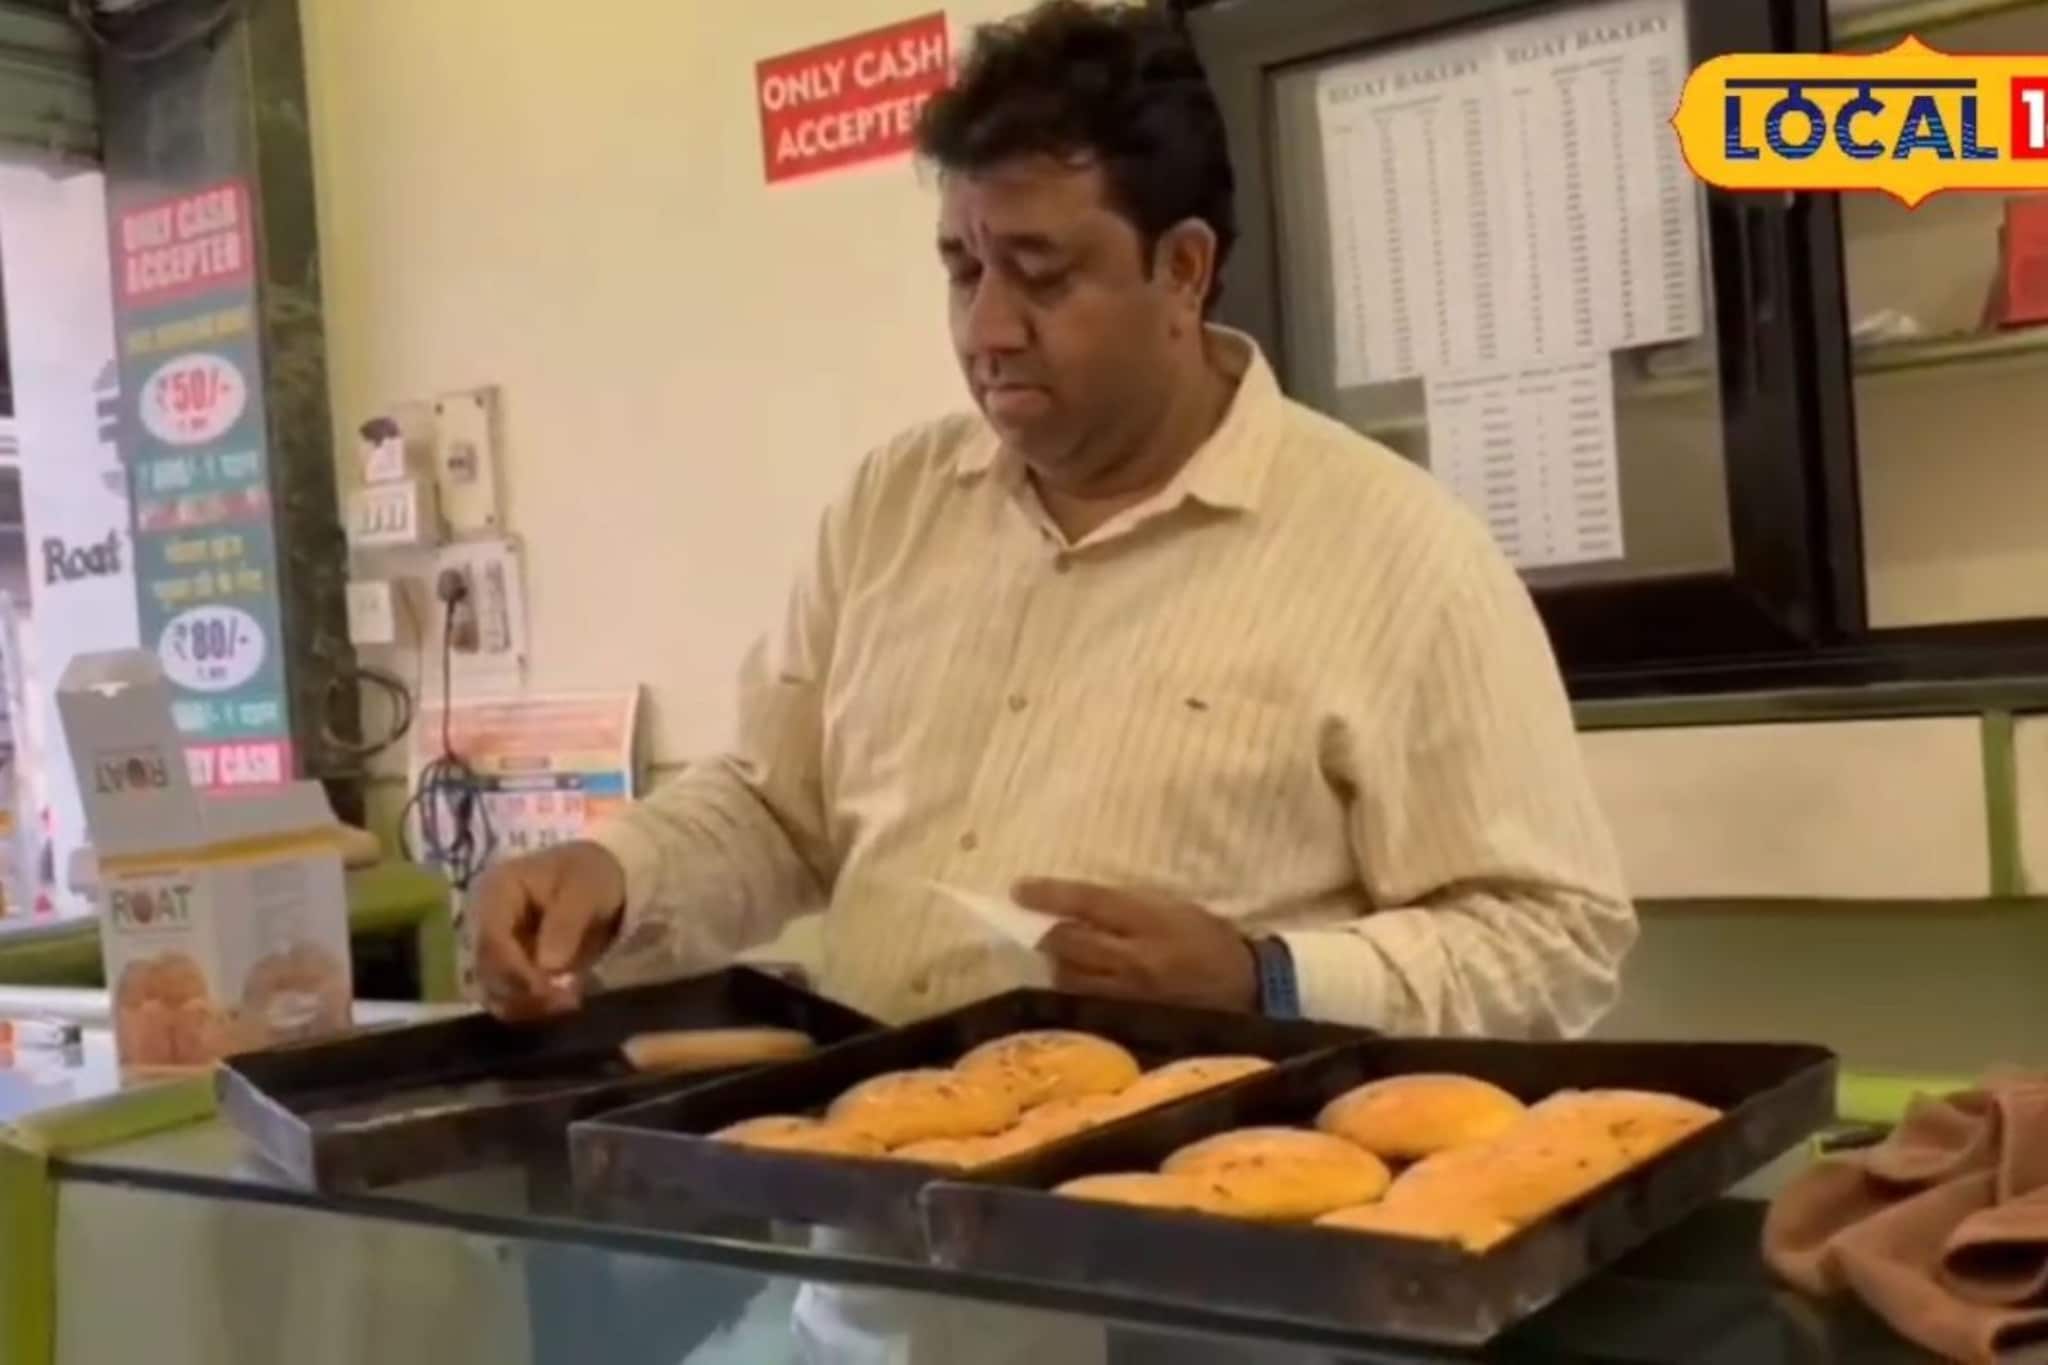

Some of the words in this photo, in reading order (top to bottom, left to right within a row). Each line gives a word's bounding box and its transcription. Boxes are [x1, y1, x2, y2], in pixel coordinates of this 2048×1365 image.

[1573, 15, 1668, 51] BAKERY
[763, 58, 846, 111] ONLY
[852, 34, 943, 88] CASH
[42, 528, 121, 584] Roat
[110, 884, 191, 929] ROAT
